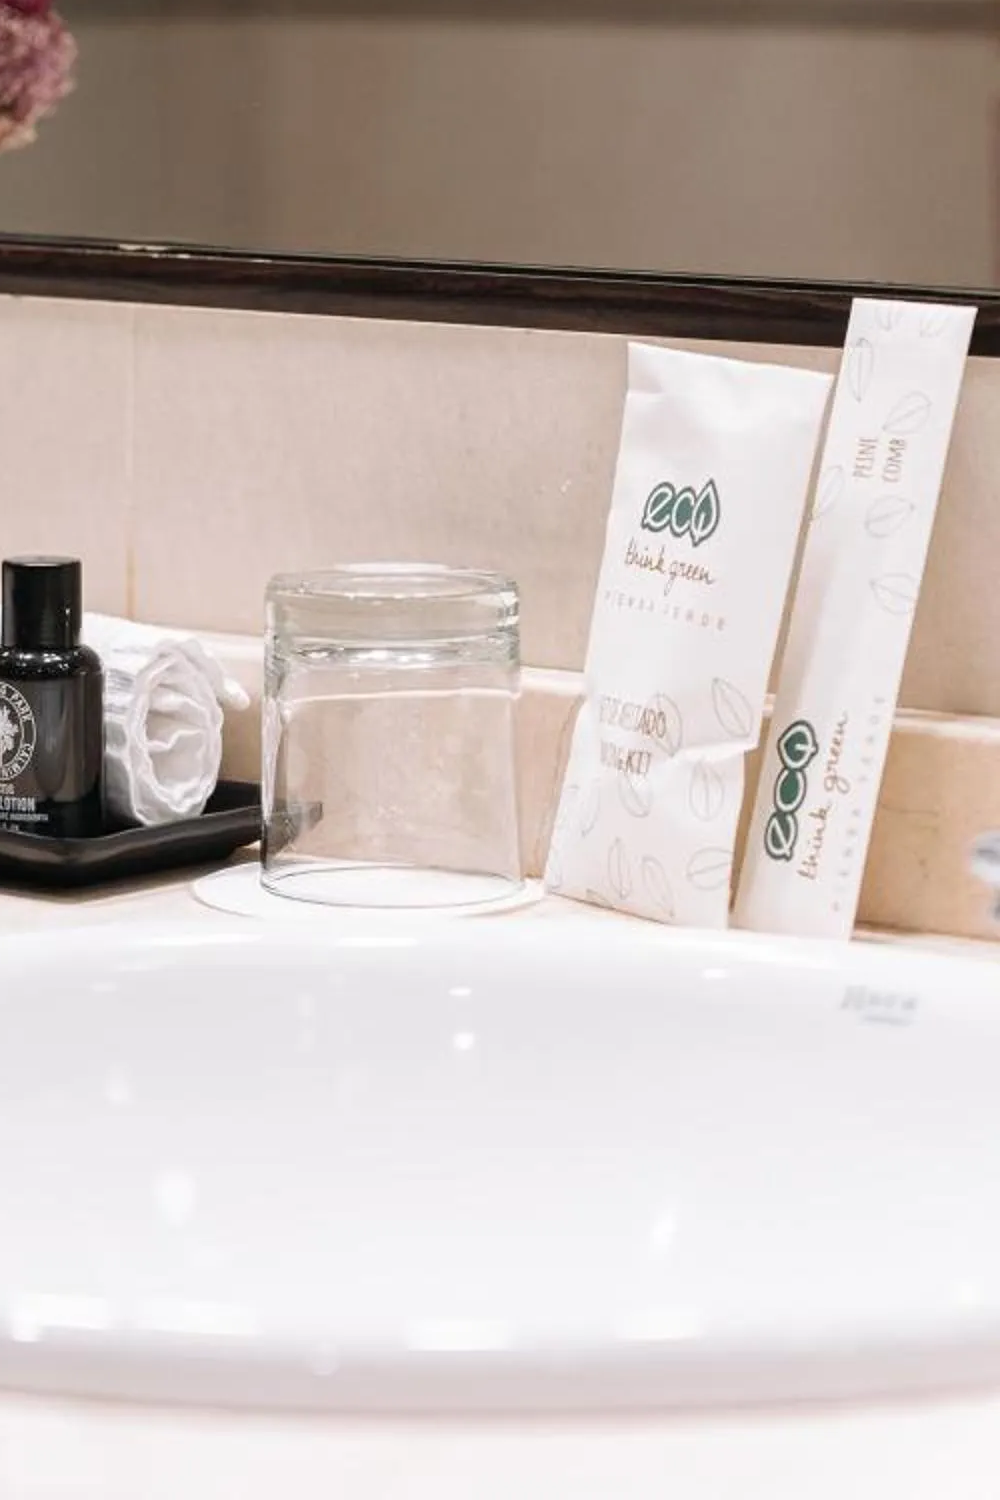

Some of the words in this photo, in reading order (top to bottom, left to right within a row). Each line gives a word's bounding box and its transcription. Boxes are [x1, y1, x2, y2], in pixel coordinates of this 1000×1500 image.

[624, 536, 666, 575] think
[664, 560, 716, 597] green
[0, 796, 36, 813] LOTION
[764, 719, 819, 862] eco
[797, 798, 833, 881] think
[823, 709, 850, 795] green
